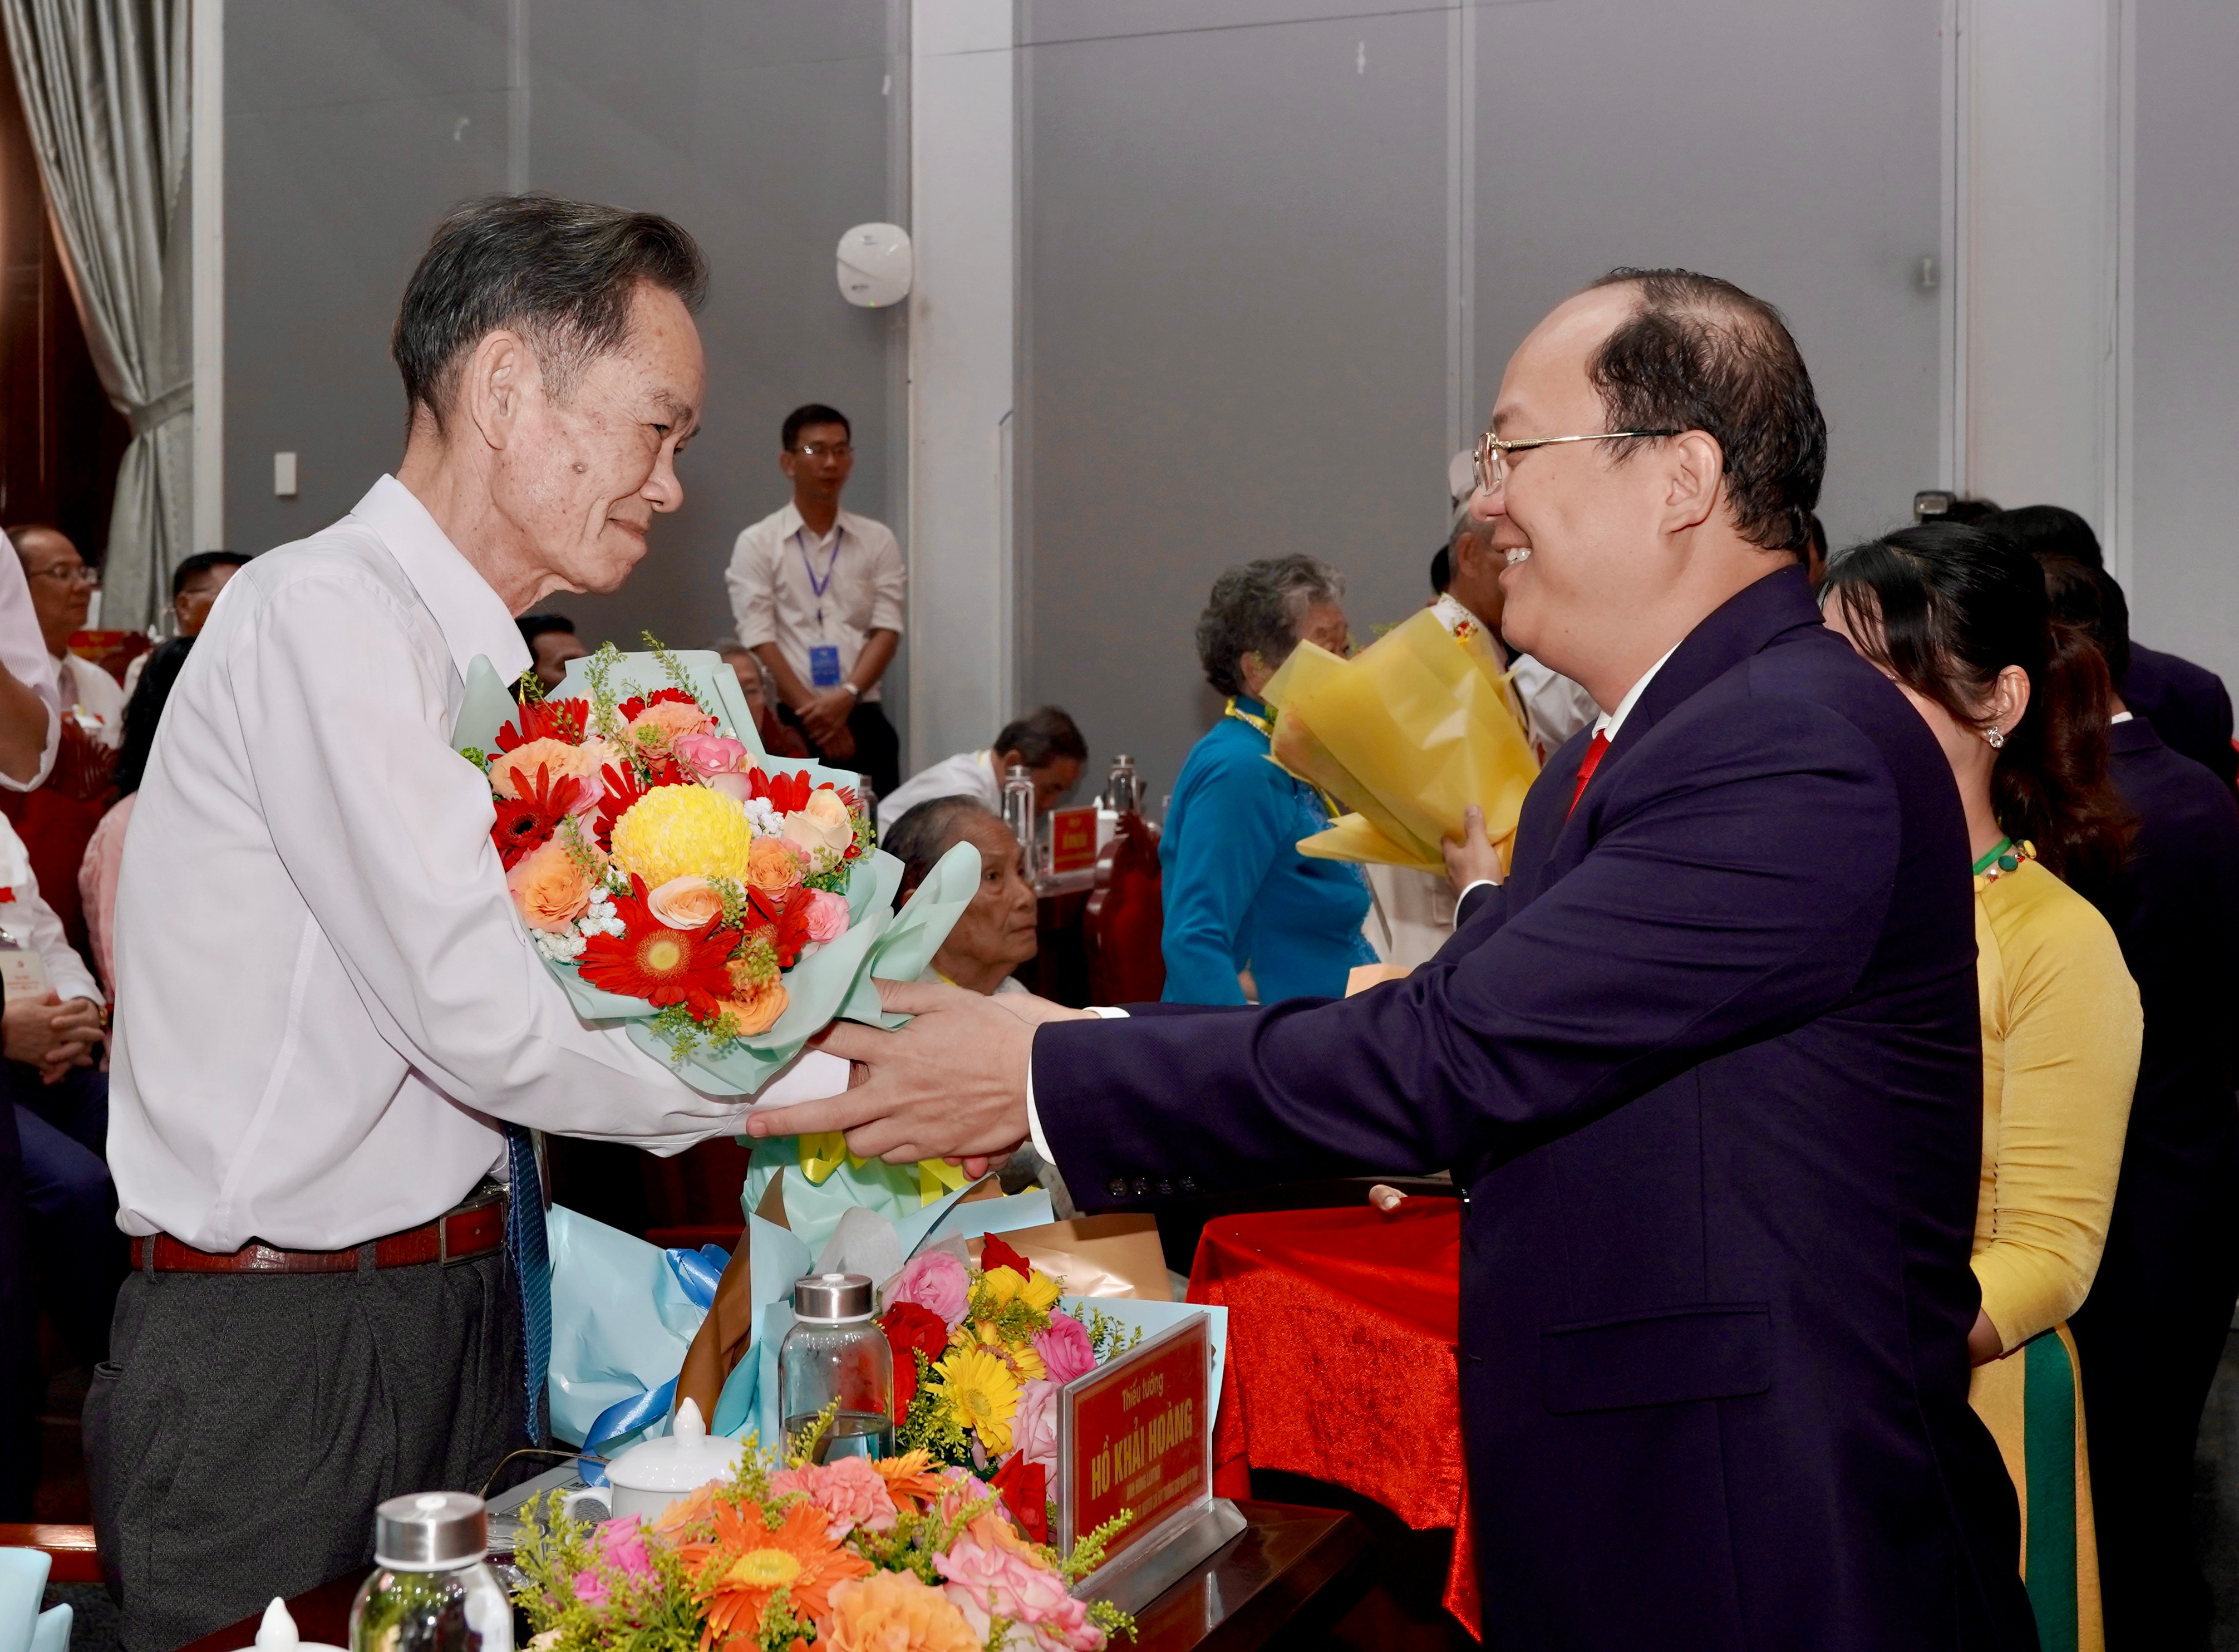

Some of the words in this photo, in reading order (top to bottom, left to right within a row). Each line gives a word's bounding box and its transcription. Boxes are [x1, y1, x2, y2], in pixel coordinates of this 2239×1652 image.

[1122, 1377, 1141, 1412] Thiếu
[1091, 1434, 1110, 1501] HỒ
[1114, 1416, 1145, 1486] KHẢI
[1149, 1397, 1193, 1462] HOÀNG
